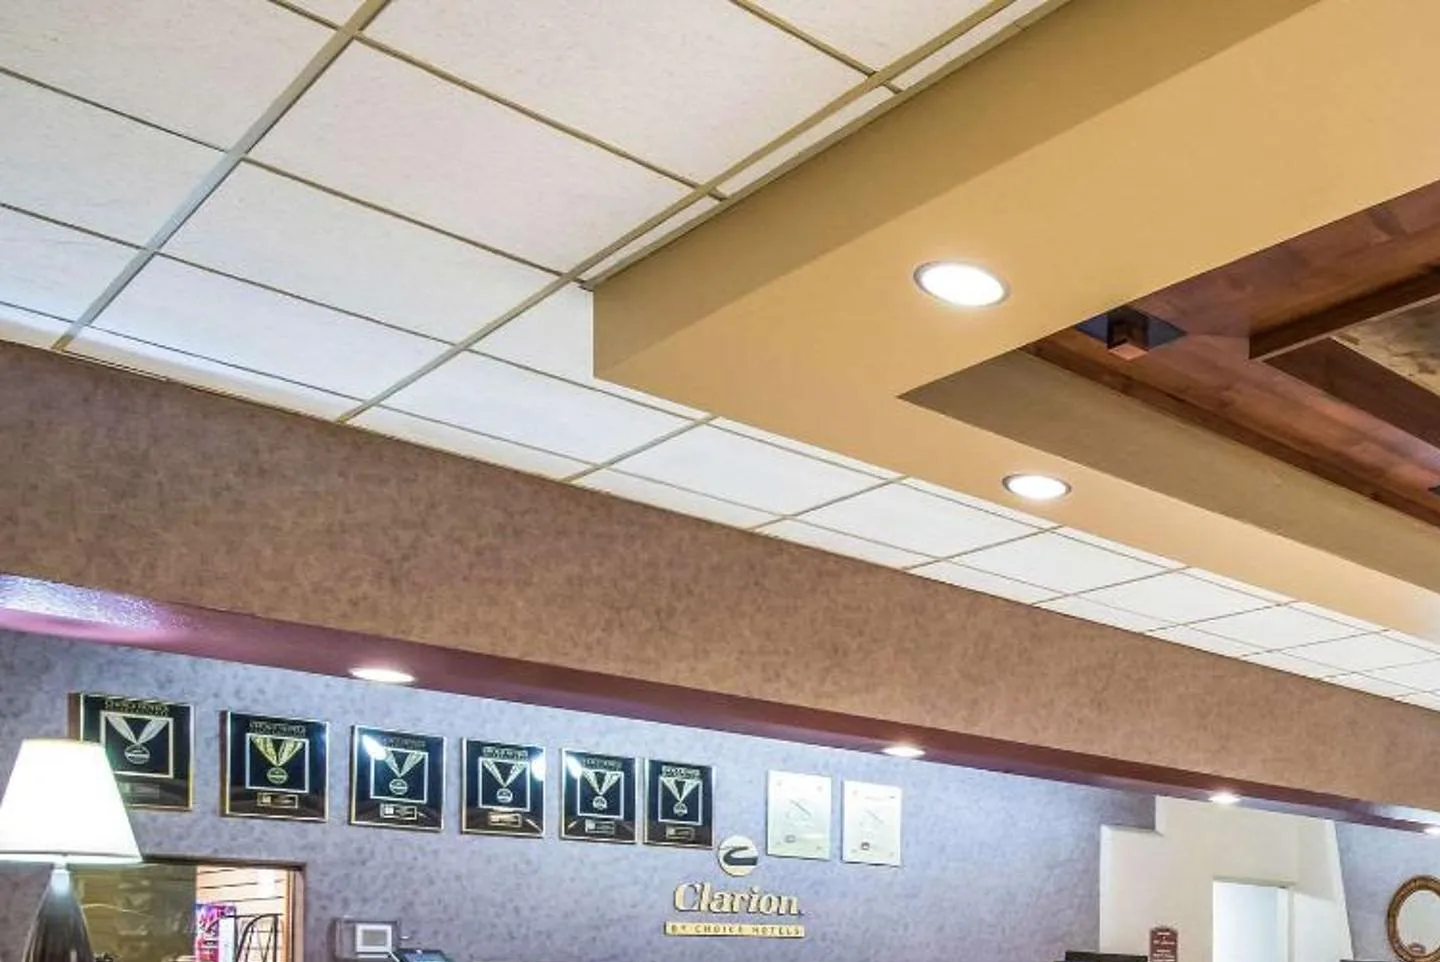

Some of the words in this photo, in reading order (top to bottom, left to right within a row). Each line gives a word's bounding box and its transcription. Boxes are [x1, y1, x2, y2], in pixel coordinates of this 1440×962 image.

[674, 881, 802, 915] Clarion
[671, 924, 687, 934] BY
[694, 924, 743, 935] CHOICE
[751, 925, 800, 936] HOTELS
